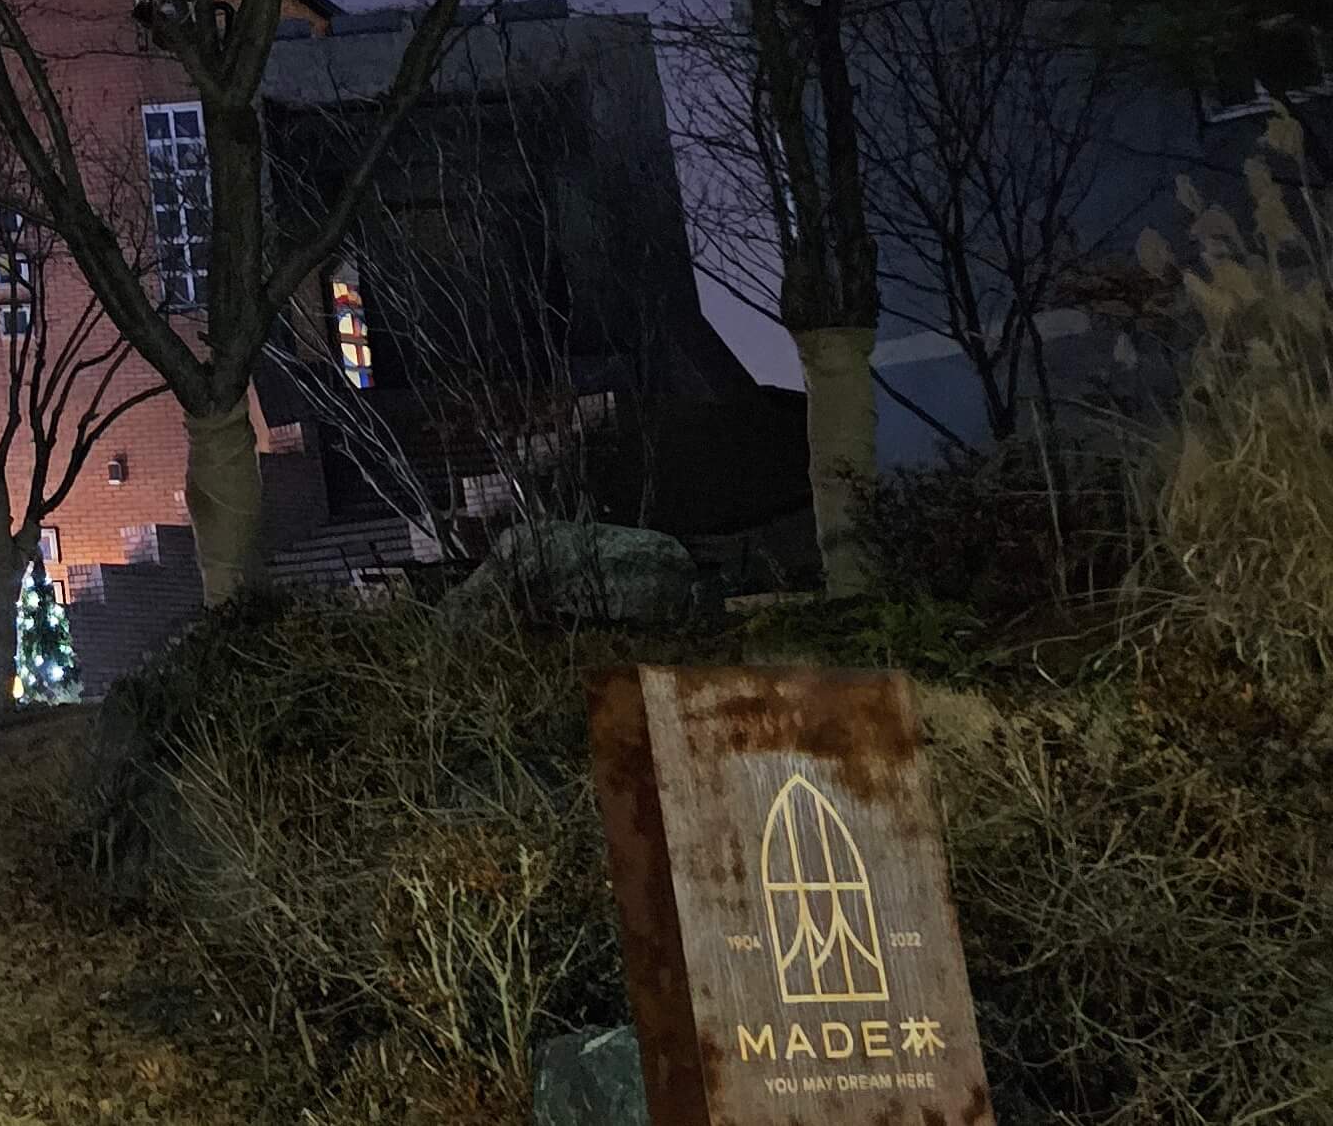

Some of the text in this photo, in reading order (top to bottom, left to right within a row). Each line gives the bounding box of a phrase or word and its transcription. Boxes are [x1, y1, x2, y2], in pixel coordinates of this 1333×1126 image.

[889, 931, 922, 947] 2022
[765, 1072, 934, 1095] YOU MAY DREAM HERE
